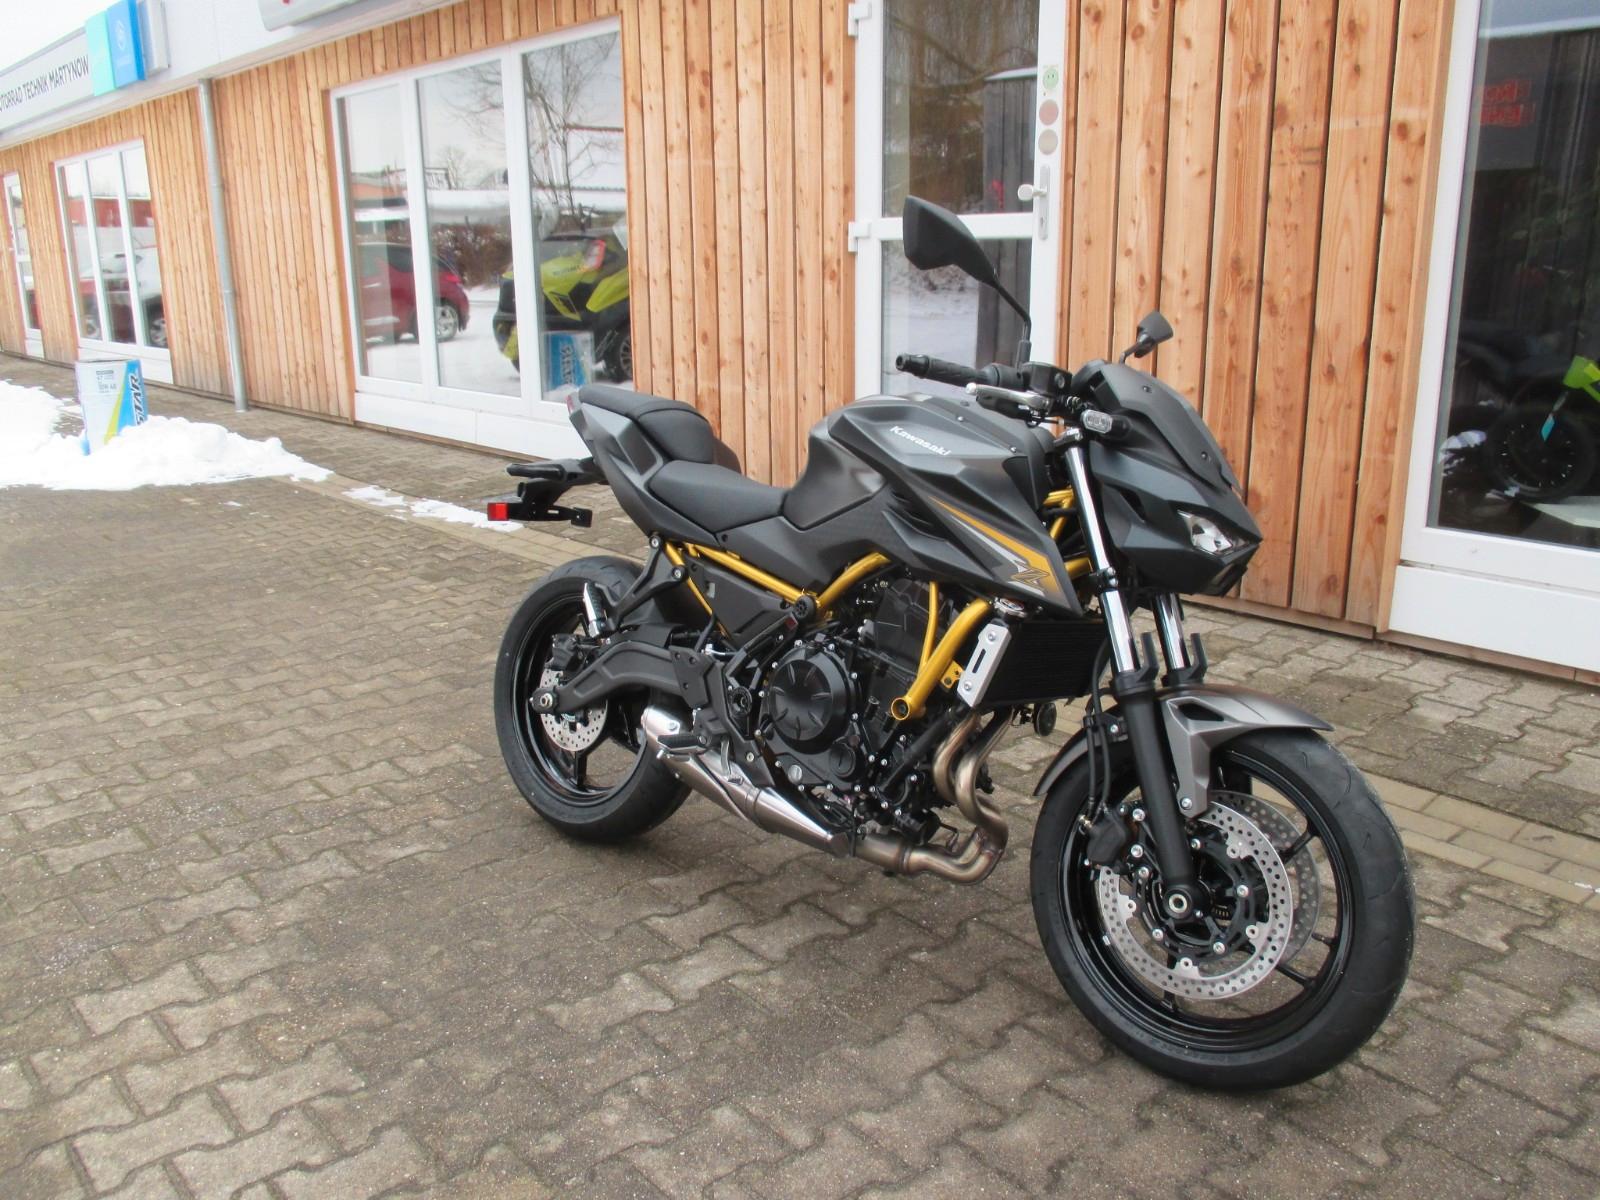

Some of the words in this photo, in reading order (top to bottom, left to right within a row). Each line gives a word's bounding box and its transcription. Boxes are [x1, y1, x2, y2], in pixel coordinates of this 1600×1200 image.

[22, 74, 49, 101] TECHNIK
[48, 54, 89, 92] MARTYNOW
[890, 425, 952, 456] Kawasaki
